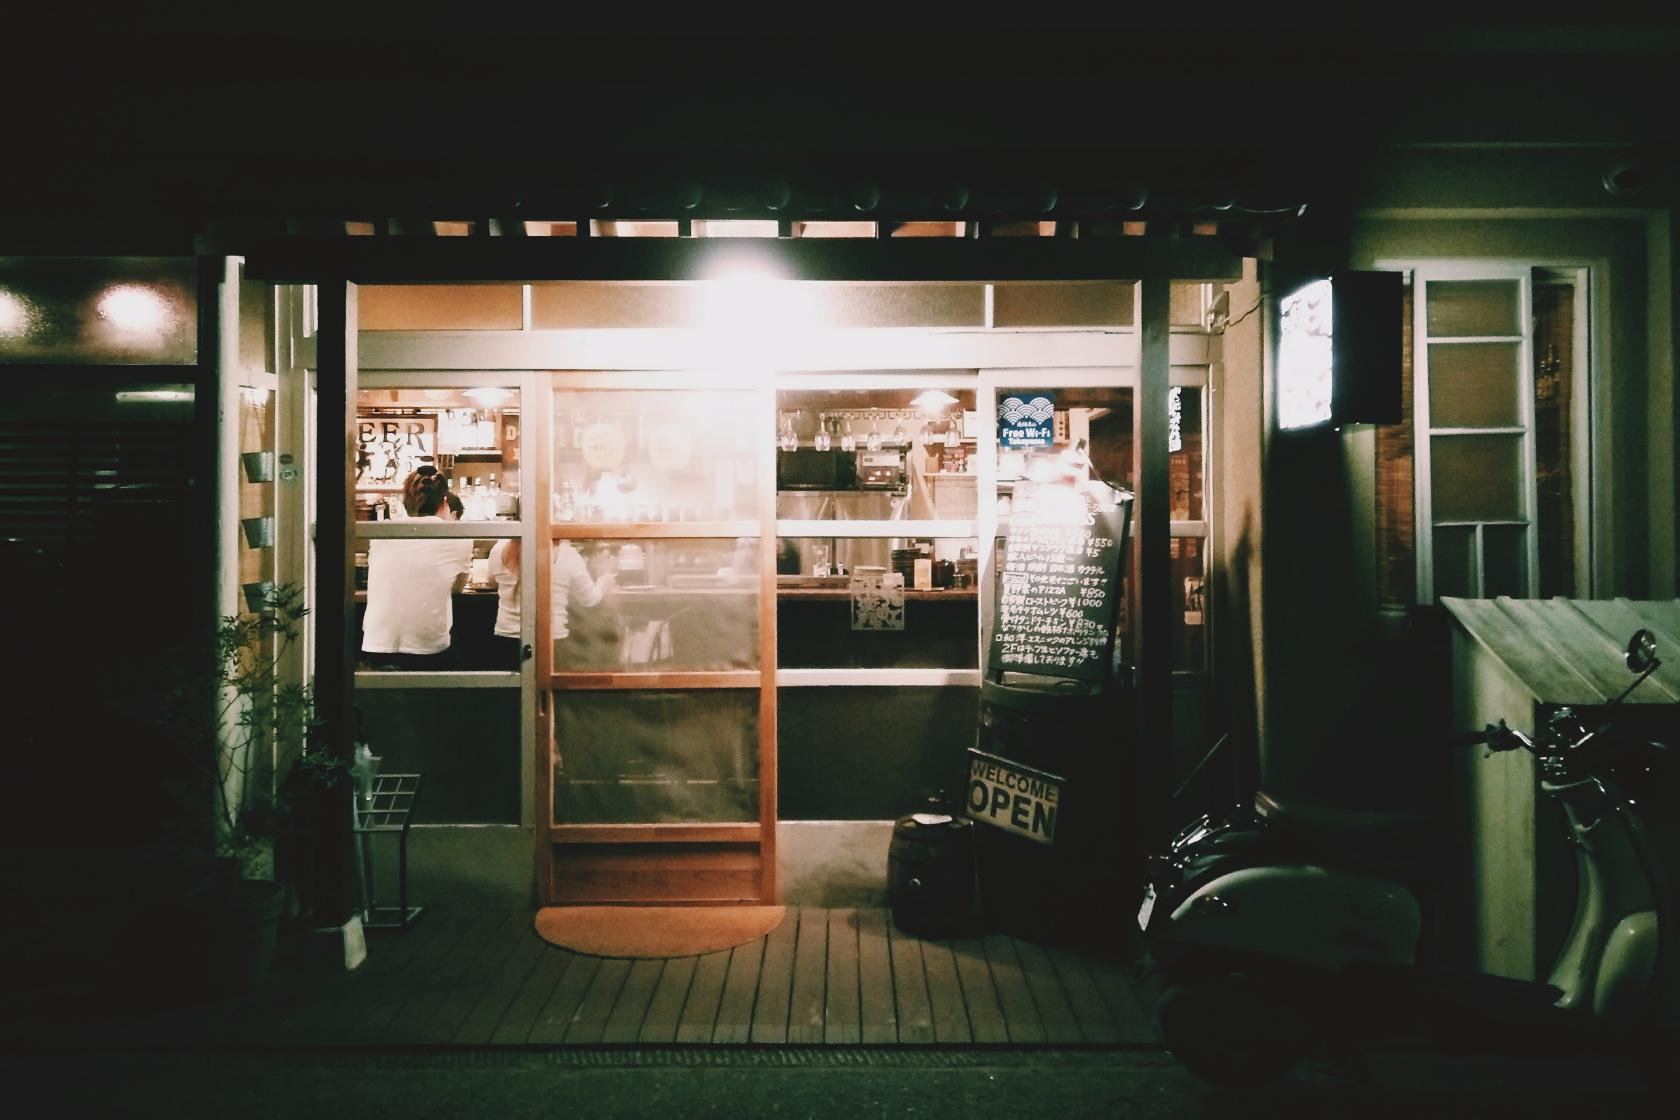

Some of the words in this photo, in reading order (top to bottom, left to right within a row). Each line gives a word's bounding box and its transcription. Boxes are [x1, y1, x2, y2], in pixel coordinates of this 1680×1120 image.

[359, 422, 426, 452] EER
[1002, 427, 1025, 438] Free
[1025, 427, 1051, 438] Wi-Fi
[1080, 587, 1106, 599] ¥850
[1068, 597, 1103, 609] ¥1000
[1059, 608, 1084, 619] ¥600
[971, 760, 1058, 802] WELCOME
[969, 779, 1057, 838] OPEN
